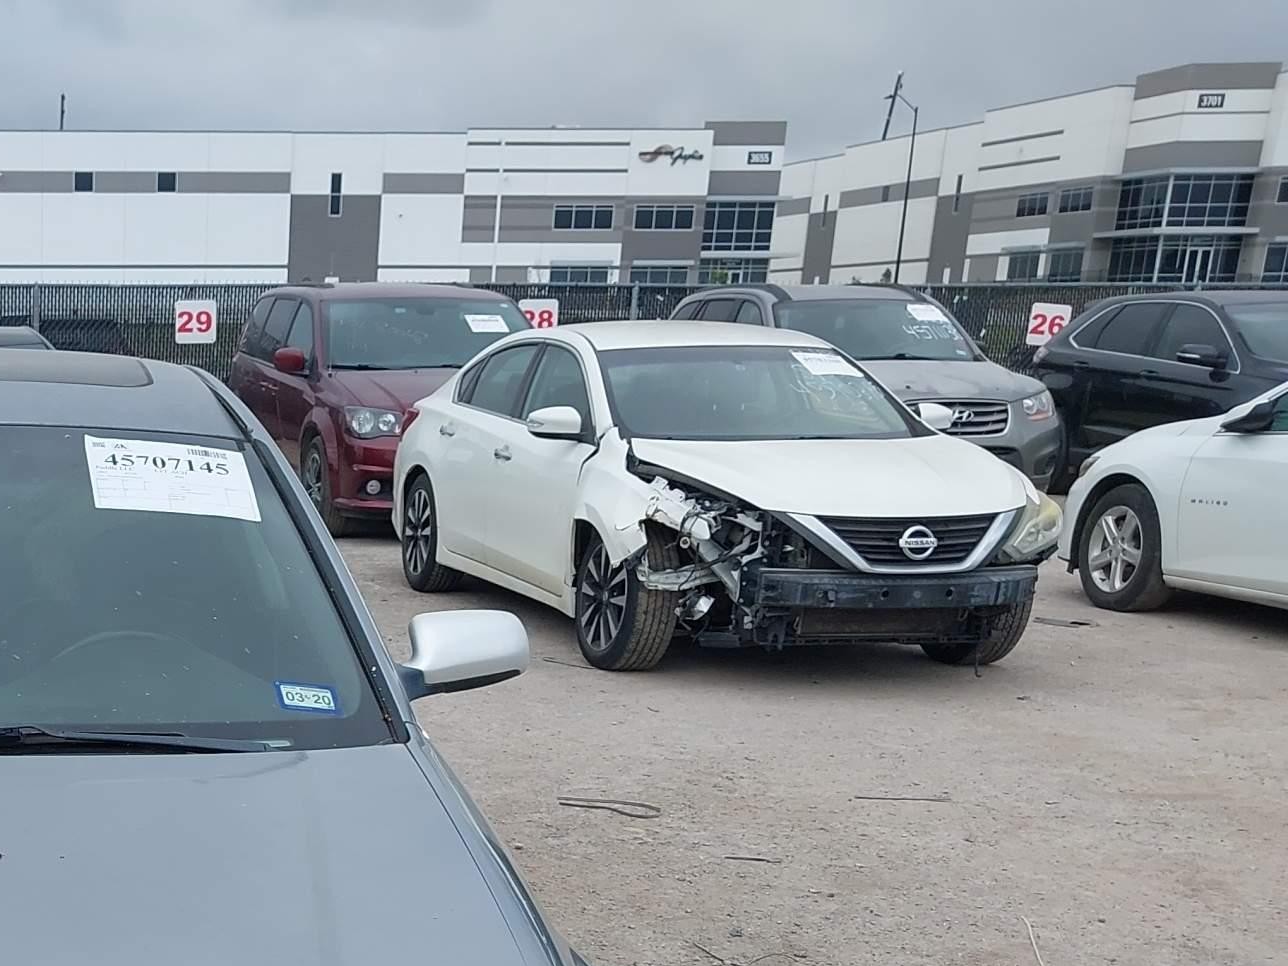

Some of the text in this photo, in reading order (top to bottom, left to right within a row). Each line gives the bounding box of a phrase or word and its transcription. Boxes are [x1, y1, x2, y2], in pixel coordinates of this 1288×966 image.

[178, 311, 212, 333] 29
[1029, 314, 1065, 336] 26
[104, 453, 230, 476] 45707145
